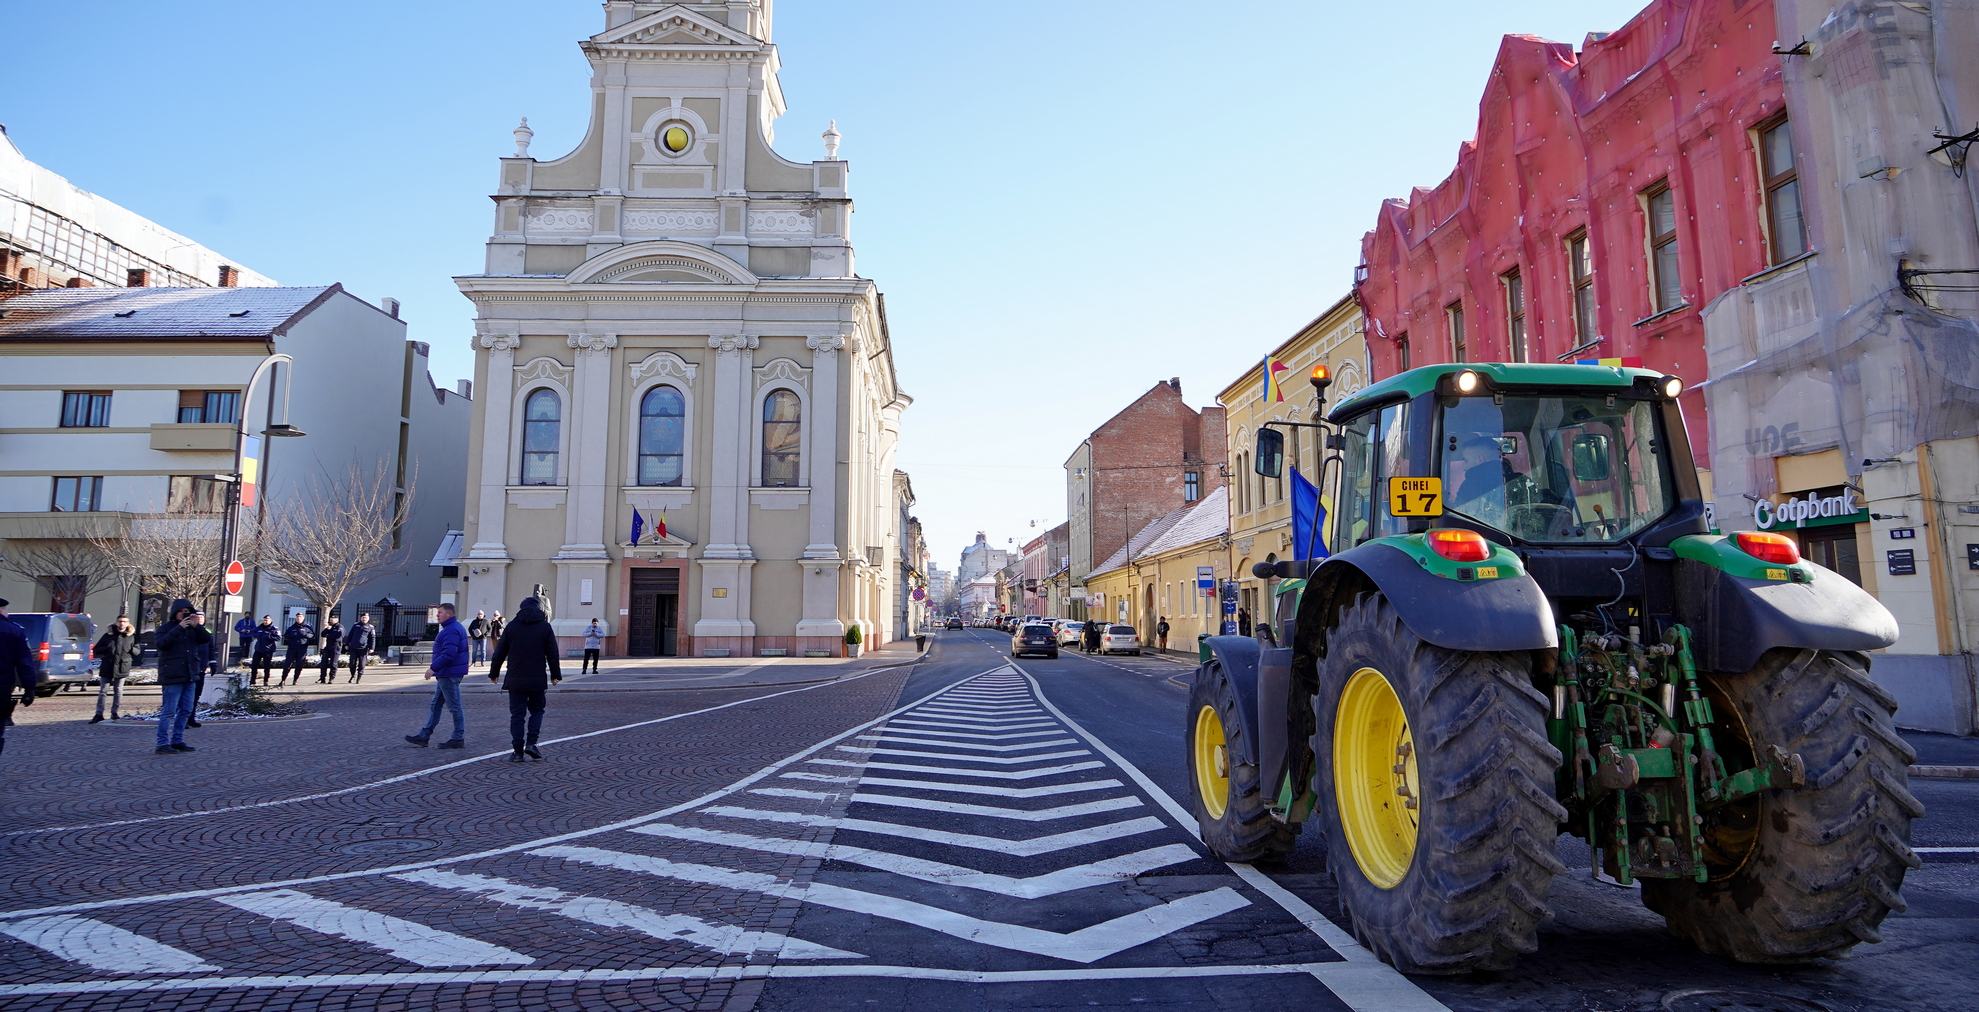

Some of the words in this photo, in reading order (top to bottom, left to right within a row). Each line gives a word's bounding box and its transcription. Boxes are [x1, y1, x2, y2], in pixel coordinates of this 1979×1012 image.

[1402, 481, 1429, 491] CIHEI
[1397, 493, 1438, 513] 17
[1776, 486, 1860, 528] otpbank
